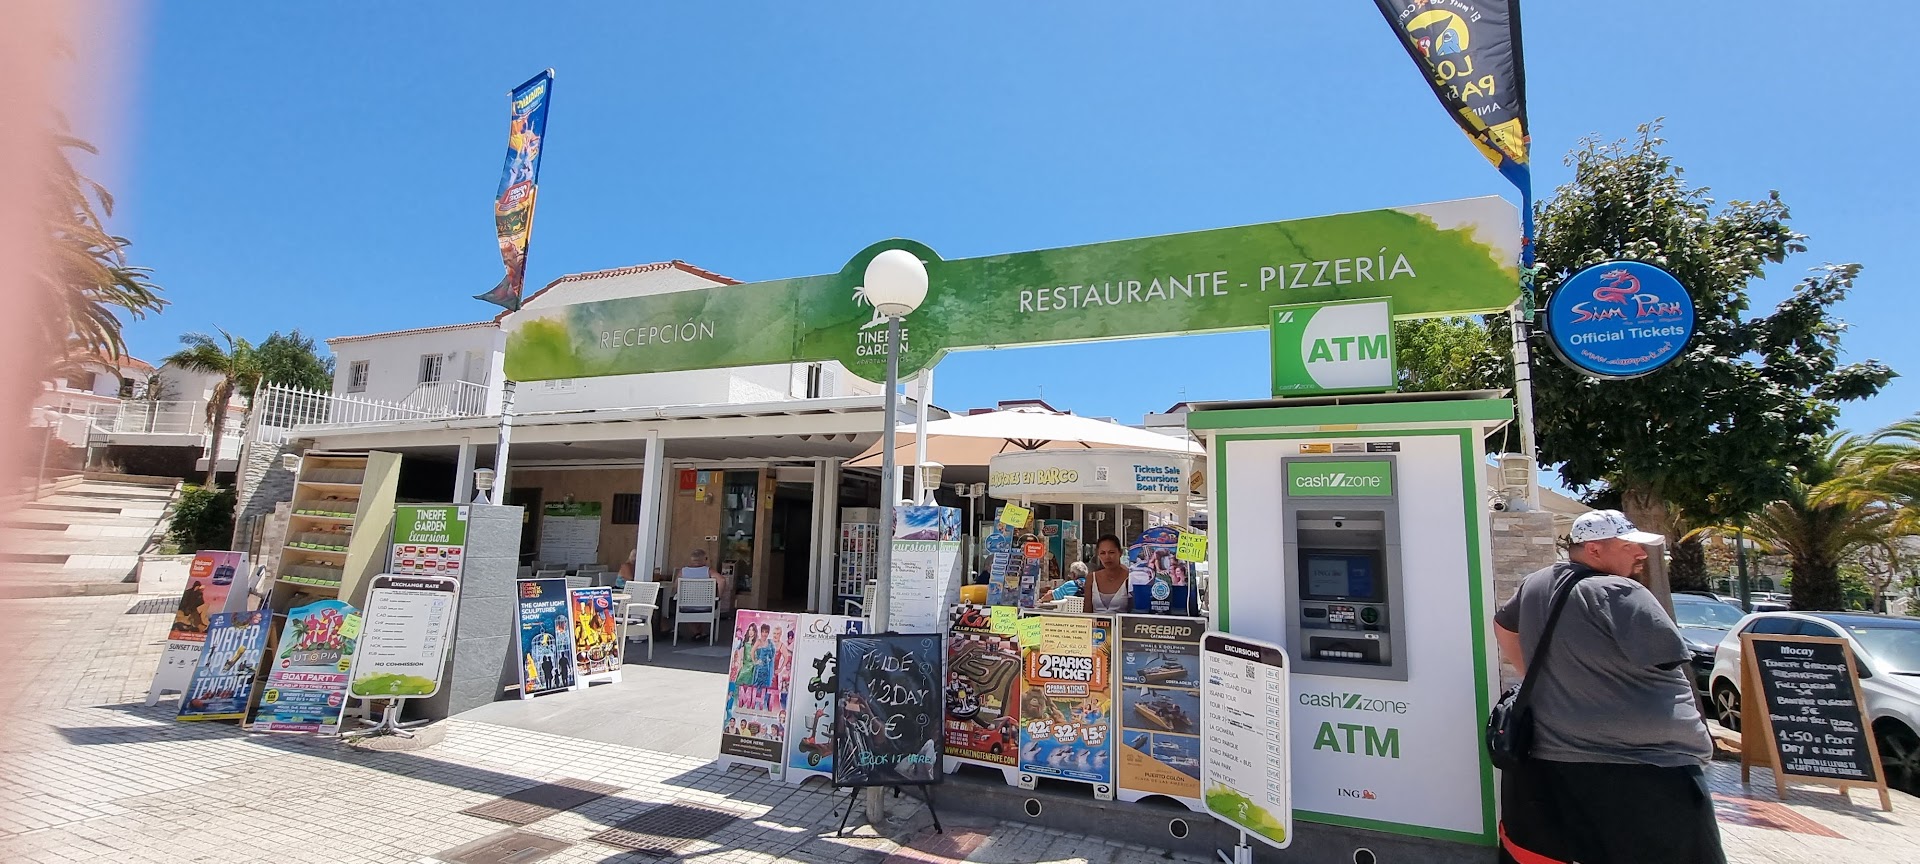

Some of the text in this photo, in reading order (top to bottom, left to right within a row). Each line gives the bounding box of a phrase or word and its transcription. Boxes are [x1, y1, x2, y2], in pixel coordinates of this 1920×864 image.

[1019, 271, 1228, 313] RESTAURANTE
[1260, 247, 1416, 291] PIZZERÍA
[600, 317, 715, 349] RECEPCIÓN
[1570, 325, 1685, 345] Official Tickets
[856, 341, 909, 356] GARDN
[1308, 335, 1387, 363] ATM
[1023, 467, 1078, 485] EN BARCO
[1133, 465, 1180, 474] Tickets Sale
[1136, 474, 1179, 483] Excursions
[1136, 483, 1179, 493] Boat Trips
[417, 510, 447, 520] TINERFE
[414, 521, 446, 531] GARDEN
[409, 531, 449, 542] Excursions
[1134, 624, 1191, 636] FREEBIRD
[211, 625, 261, 651] WATER
[169, 643, 191, 651] SUNSET
[1225, 644, 1260, 659] EXCURSIONS
[1781, 646, 1814, 657] Mocay
[1039, 655, 1051, 677] 2
[1051, 656, 1092, 670] PARKS
[1052, 667, 1092, 681] TICKET
[1313, 721, 1400, 759] ATM
[1338, 788, 1360, 798] ING
